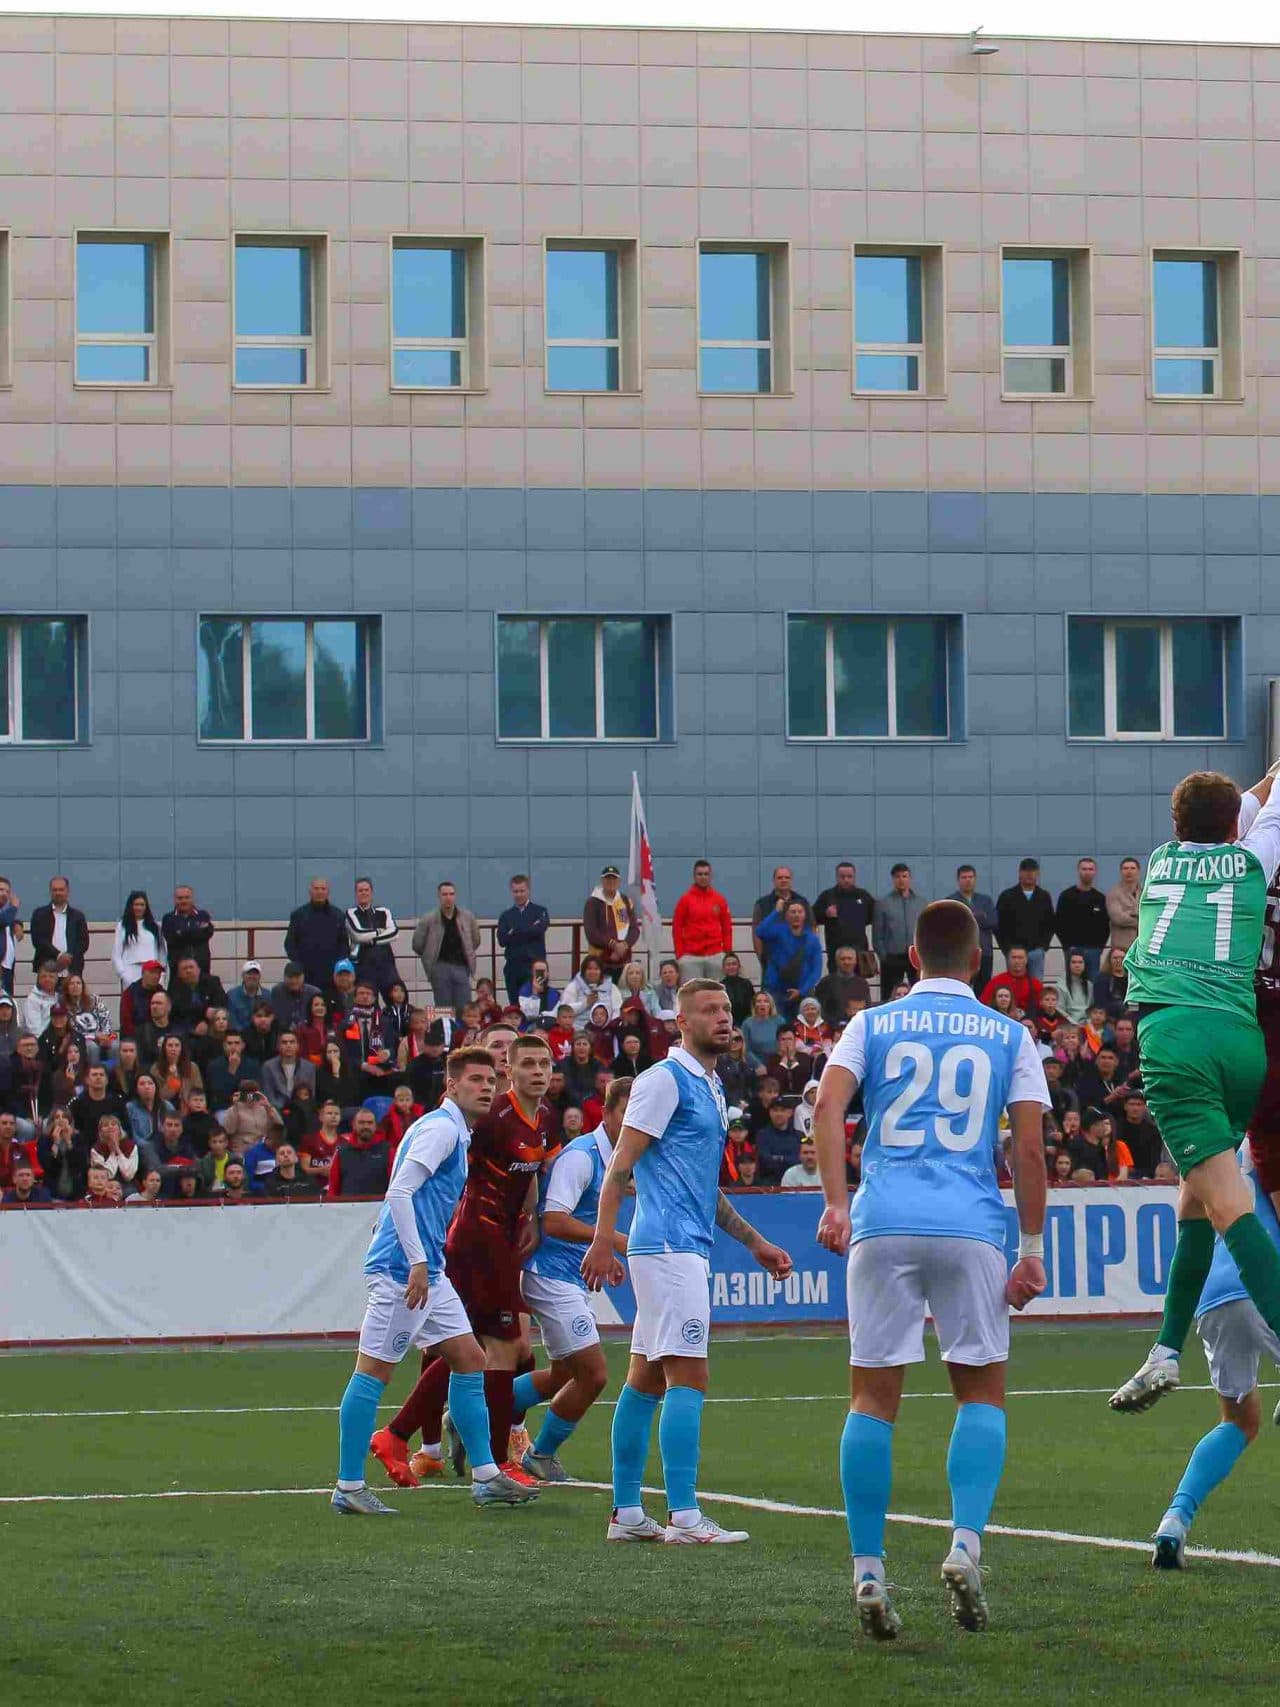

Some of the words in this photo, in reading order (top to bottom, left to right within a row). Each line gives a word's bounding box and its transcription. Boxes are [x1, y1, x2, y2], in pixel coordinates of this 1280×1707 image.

[1150, 853, 1248, 881] ФАТТАХОВ
[1146, 882, 1234, 961] 71
[873, 1010, 1010, 1045] ИГНАТОВИЧ
[880, 1041, 992, 1152] 29
[1003, 1203, 1178, 1299] ПРО
[707, 1270, 829, 1307] АЗПРОМ
